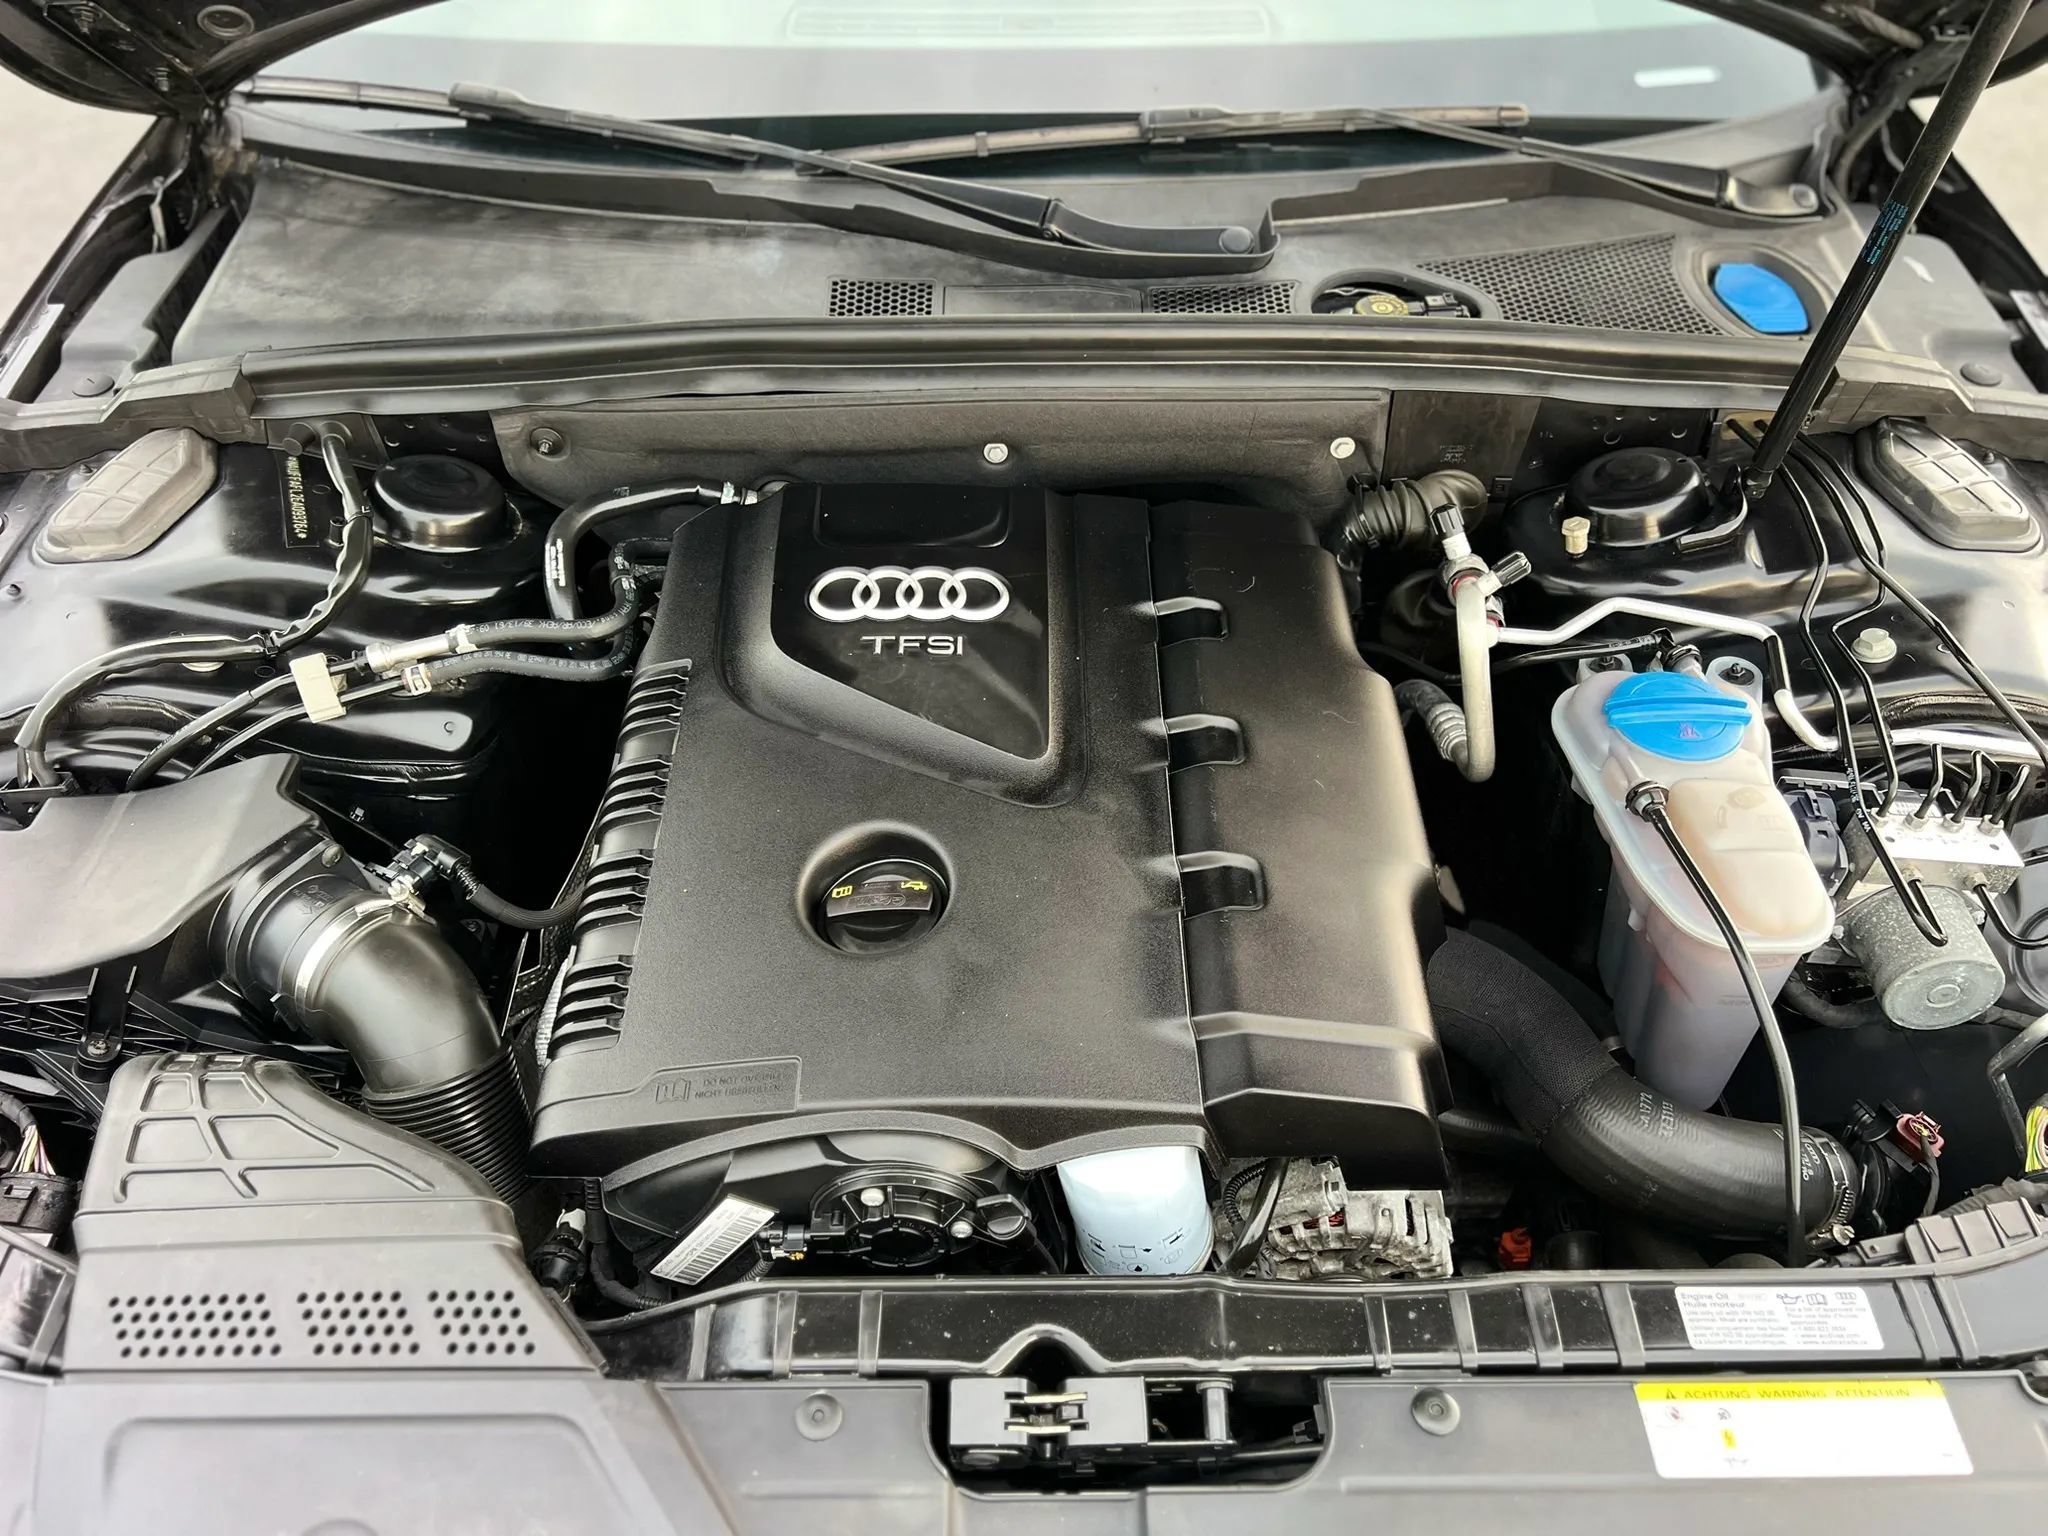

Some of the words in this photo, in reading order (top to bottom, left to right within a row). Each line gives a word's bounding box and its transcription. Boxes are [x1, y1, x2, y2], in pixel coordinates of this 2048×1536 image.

[860, 635, 964, 657] TFSI
[1680, 1293, 1713, 1301] Engine
[1715, 1292, 1729, 1300] Oil
[1684, 1389, 1751, 1399] ACHTUNG
[1758, 1389, 1827, 1399] WARNING
[1835, 1388, 1911, 1398] ATTENTION
